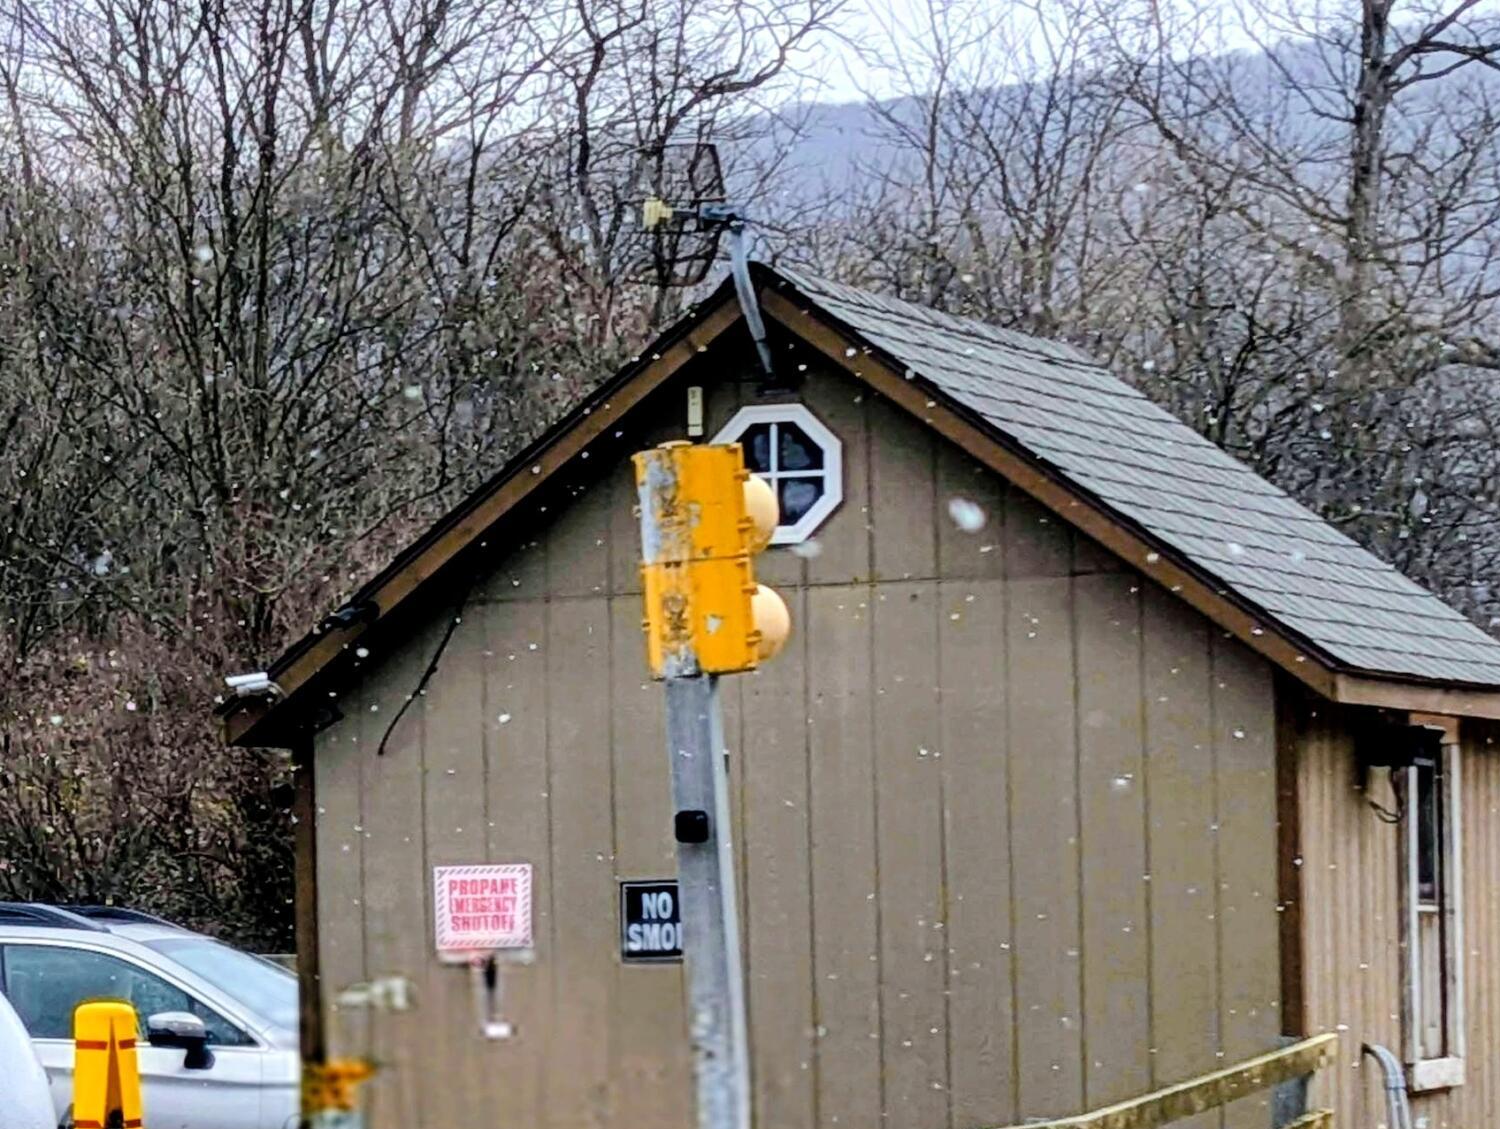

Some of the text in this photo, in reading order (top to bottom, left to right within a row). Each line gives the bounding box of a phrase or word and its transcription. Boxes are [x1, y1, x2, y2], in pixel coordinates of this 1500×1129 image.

[449, 878, 518, 896] PROPANE
[641, 891, 673, 919] NO
[451, 914, 515, 932] SHUTOFF
